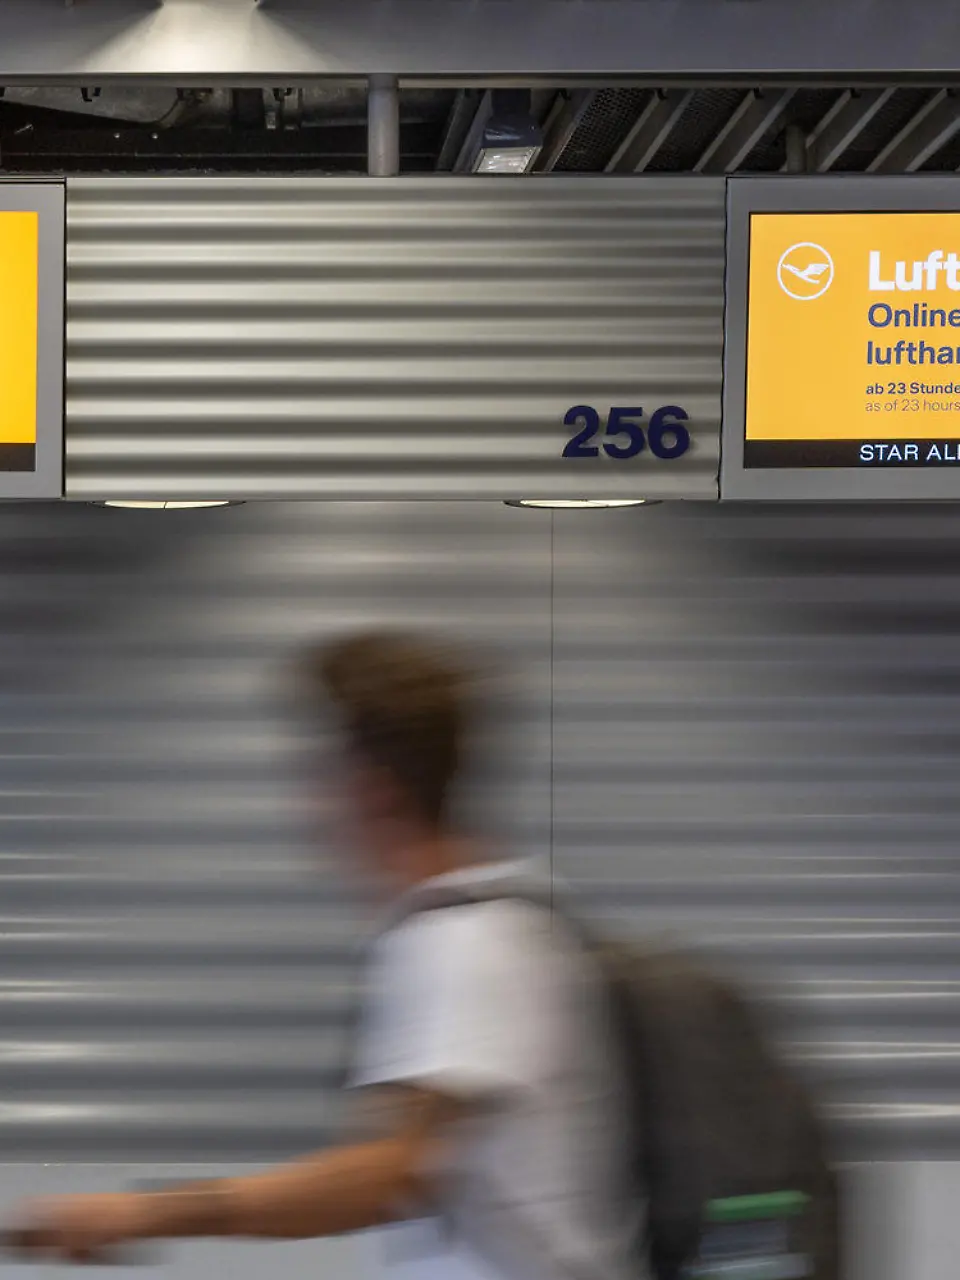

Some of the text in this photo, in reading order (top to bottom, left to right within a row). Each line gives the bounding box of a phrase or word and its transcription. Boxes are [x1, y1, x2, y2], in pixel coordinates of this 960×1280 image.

[868, 302, 960, 328] Online
[866, 382, 960, 394] ab 23 Stunde
[865, 399, 960, 412] as of 23 hours
[562, 405, 690, 459] 256
[860, 444, 960, 461] STAR AL
